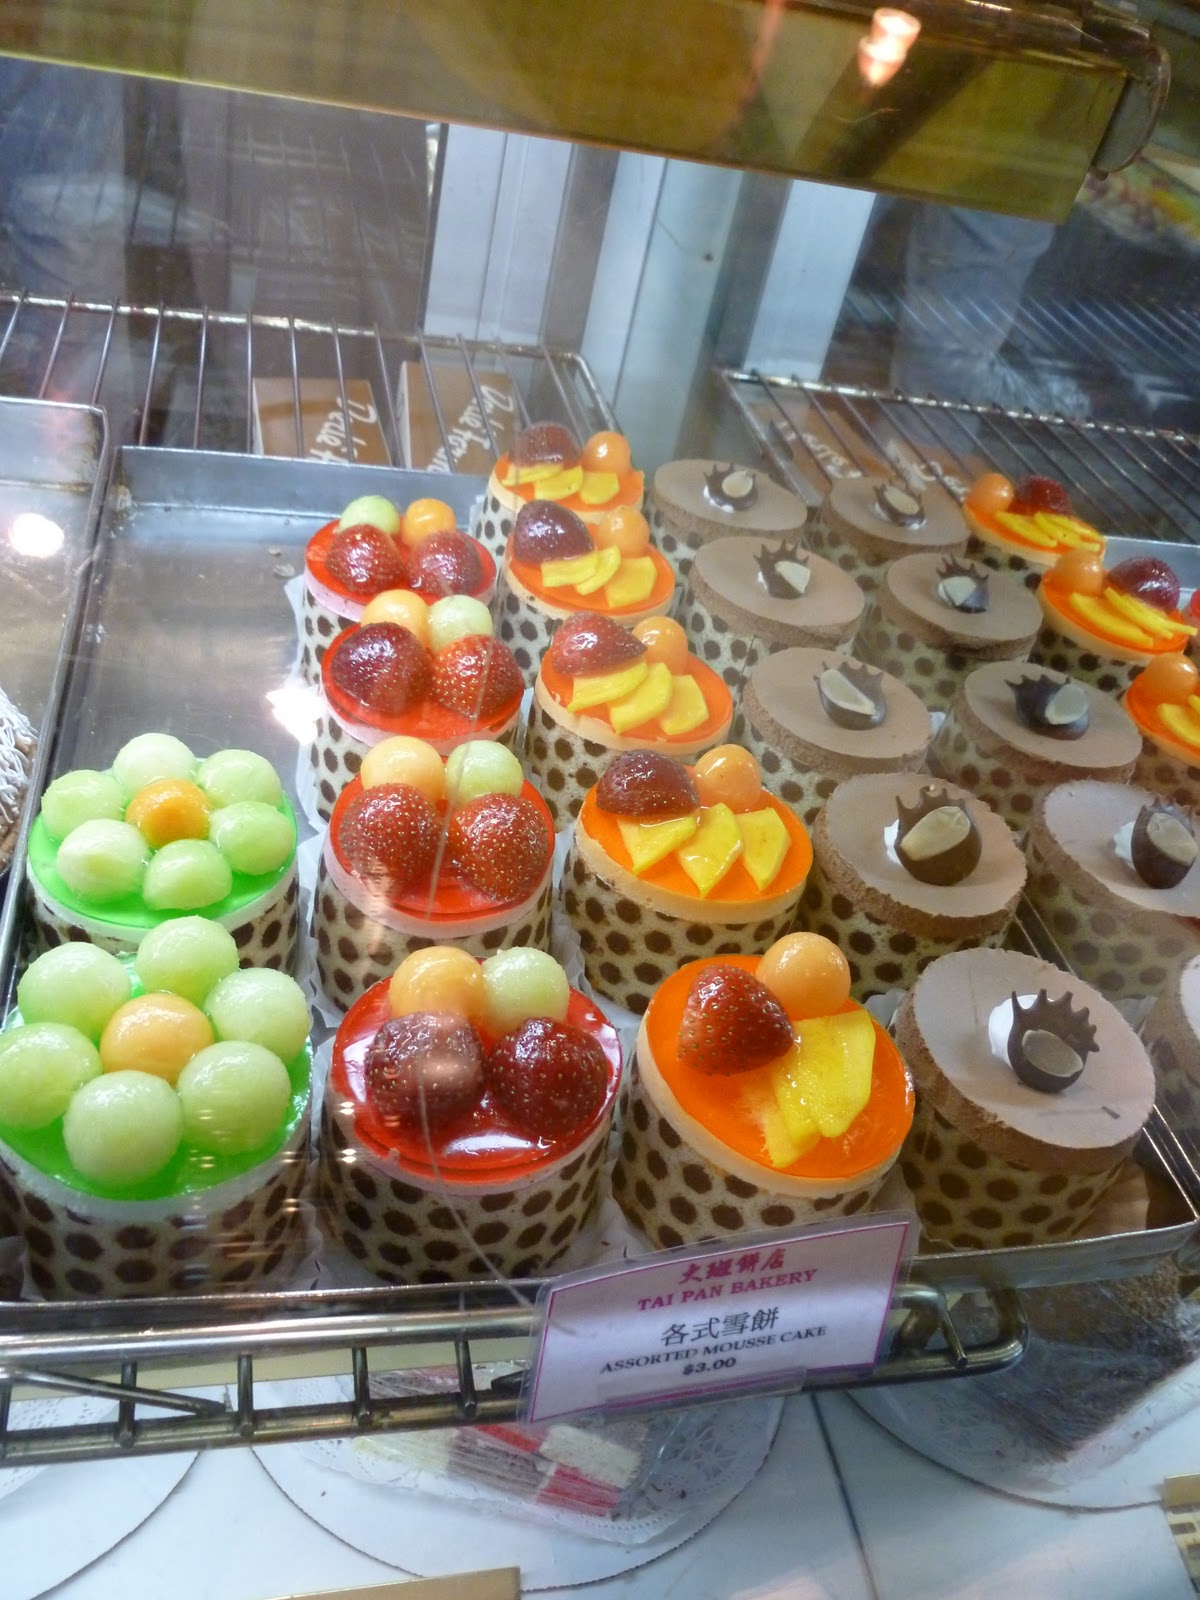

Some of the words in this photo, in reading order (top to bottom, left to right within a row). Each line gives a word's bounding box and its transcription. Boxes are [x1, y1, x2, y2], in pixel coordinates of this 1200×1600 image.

[637, 1293, 674, 1311] TAI
[680, 1284, 725, 1304] PAN
[729, 1268, 818, 1296] BAKERY
[659, 1306, 780, 1347] 各式雪餅
[599, 1348, 699, 1375] ASSORTED
[702, 1333, 777, 1357] MOUSSE
[779, 1325, 828, 1344] CAKE
[682, 1356, 737, 1376] $3.00
